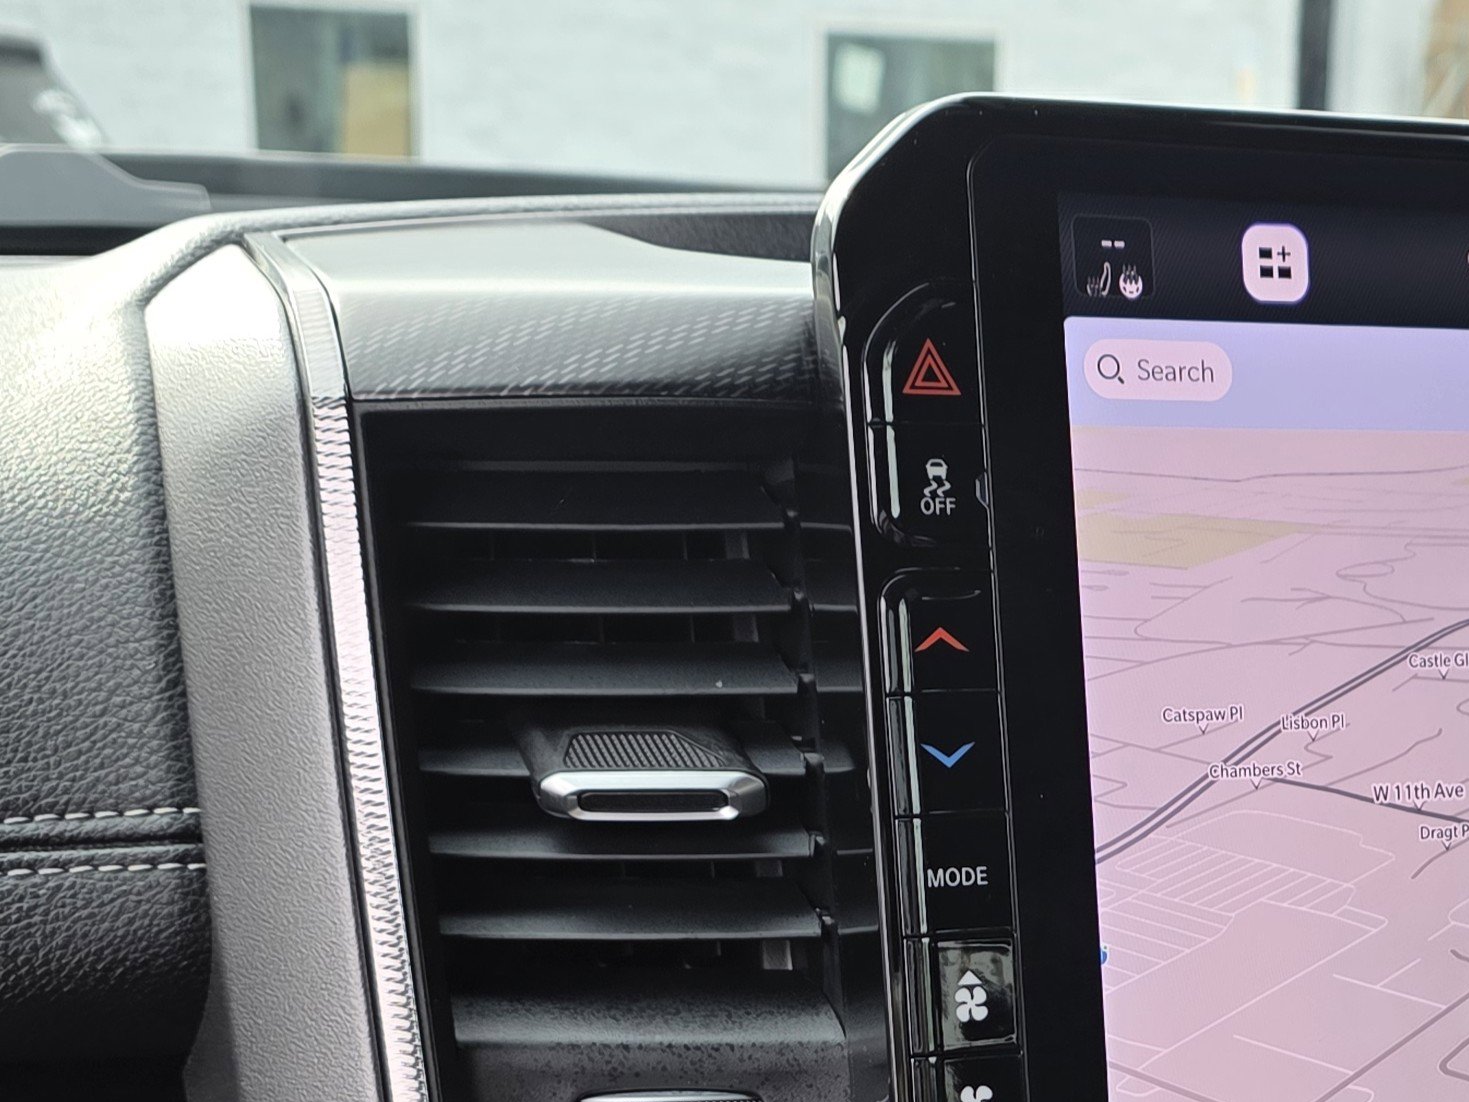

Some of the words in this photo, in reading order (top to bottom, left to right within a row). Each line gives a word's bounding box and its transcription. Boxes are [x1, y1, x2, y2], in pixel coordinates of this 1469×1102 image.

[1137, 358, 1214, 383] Search
[920, 496, 956, 516] OFF
[1408, 653, 1451, 668] Castle
[1162, 708, 1226, 724] Catspaw
[1229, 706, 1243, 721] Pl
[1281, 715, 1328, 730] Lisbon
[1331, 714, 1345, 728] Pl
[1209, 764, 1283, 779] Chambers
[1286, 762, 1302, 777] St
[1373, 785, 1390, 801] W
[1395, 784, 1431, 800] 11th
[1434, 783, 1464, 799] Ave
[1420, 825, 1458, 842] Dragt
[926, 866, 988, 888] MODE
